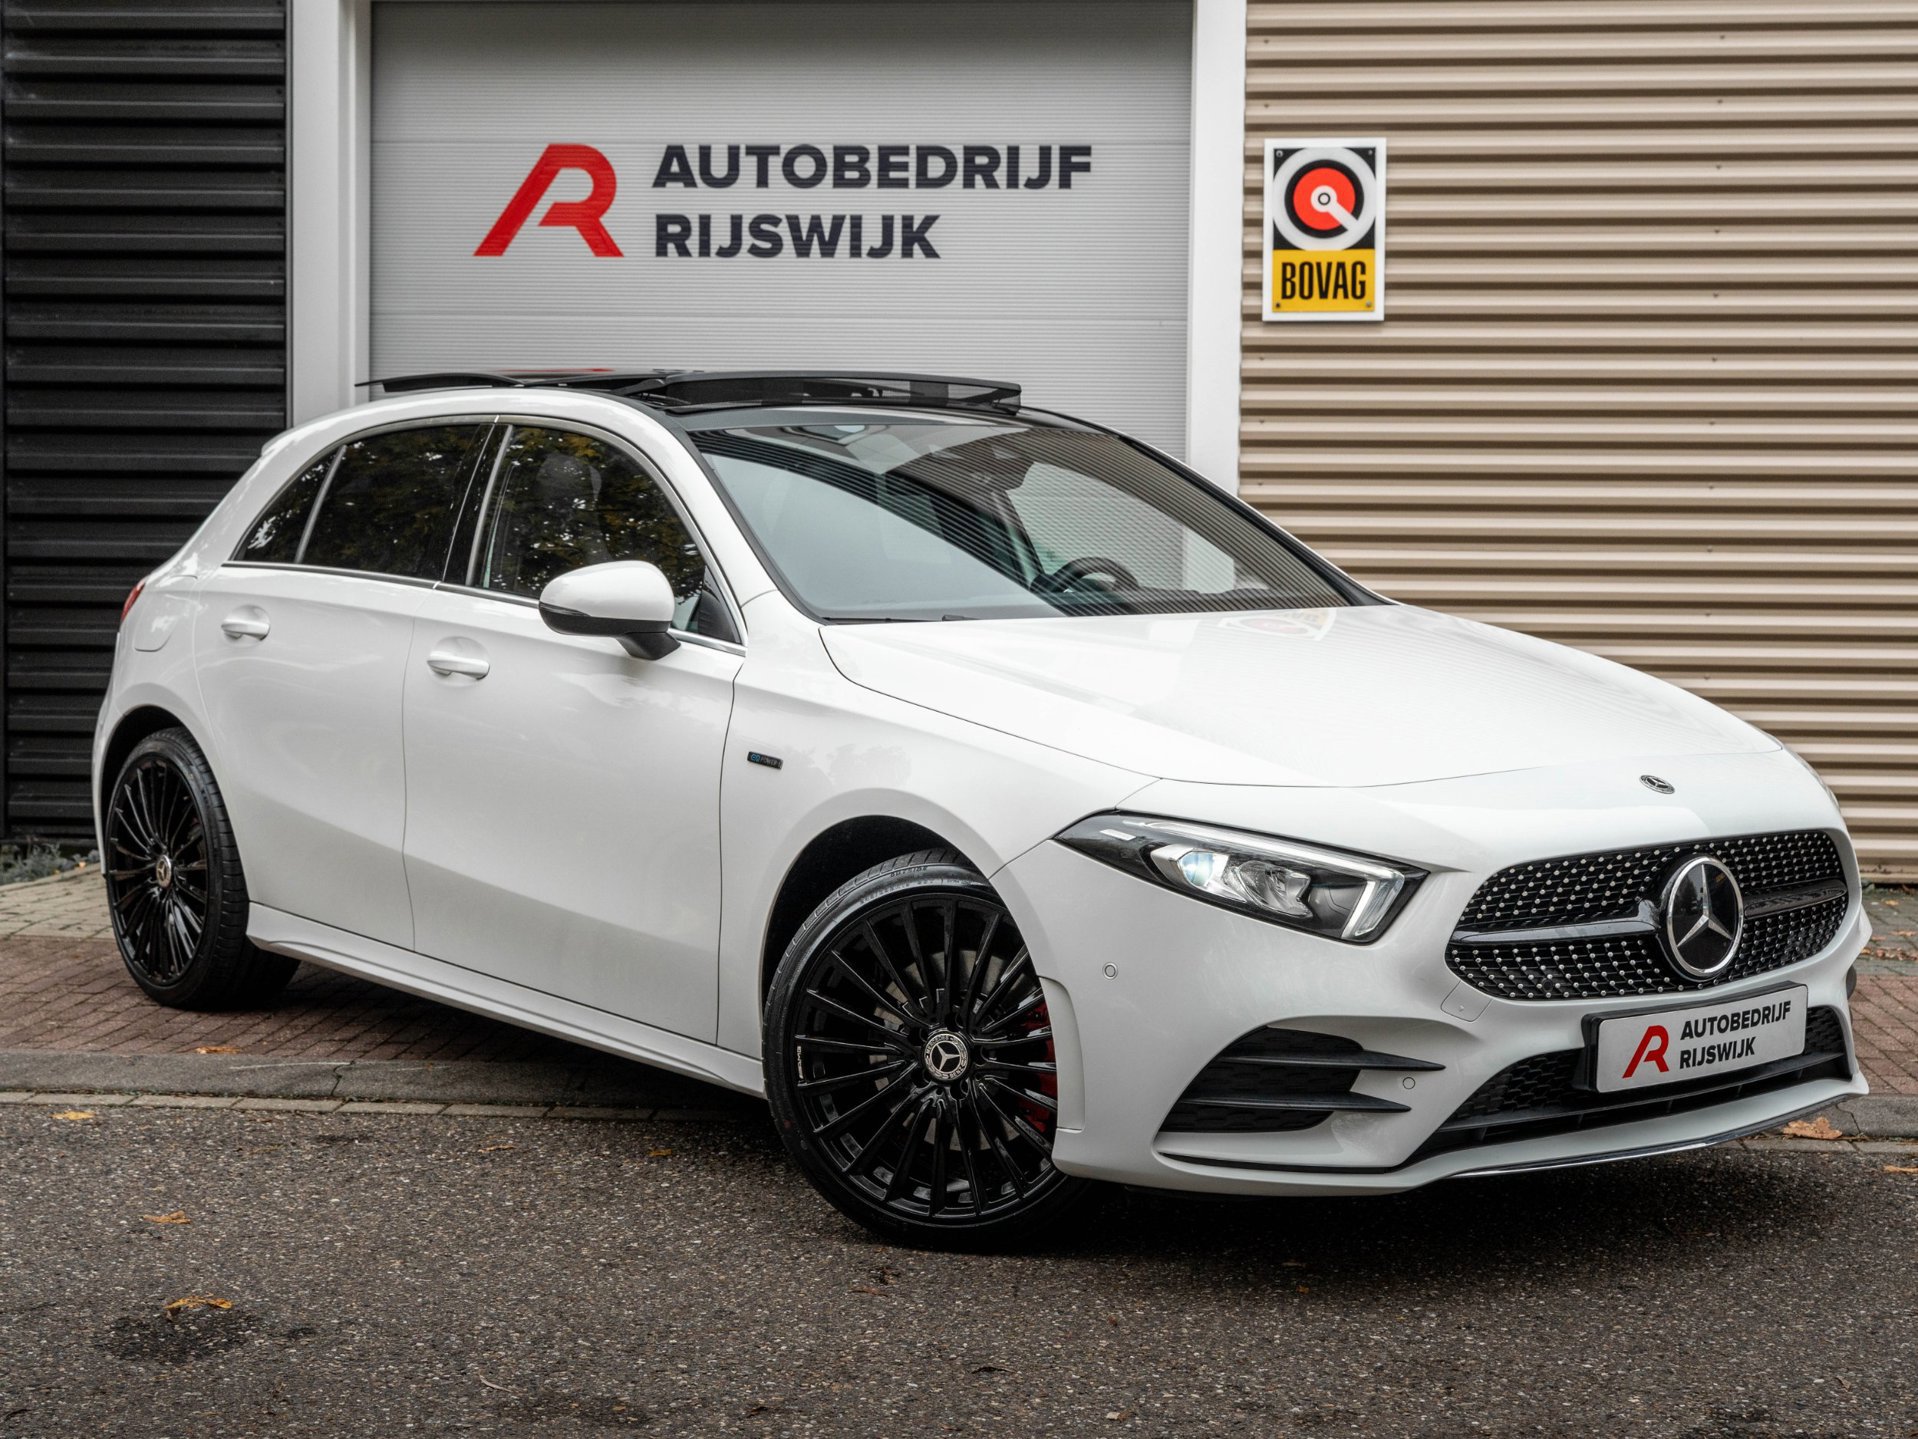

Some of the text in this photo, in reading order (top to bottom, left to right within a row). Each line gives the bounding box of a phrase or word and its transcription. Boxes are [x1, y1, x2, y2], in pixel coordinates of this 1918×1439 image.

[652, 144, 1092, 190] AUTOBEDRIJF
[655, 213, 942, 259] RIJSWIJK
[1281, 261, 1367, 300] BOVAG
[1680, 1001, 1791, 1041] AUTOBEDRIJF
[1679, 1037, 1755, 1068] RIJSWIJK
